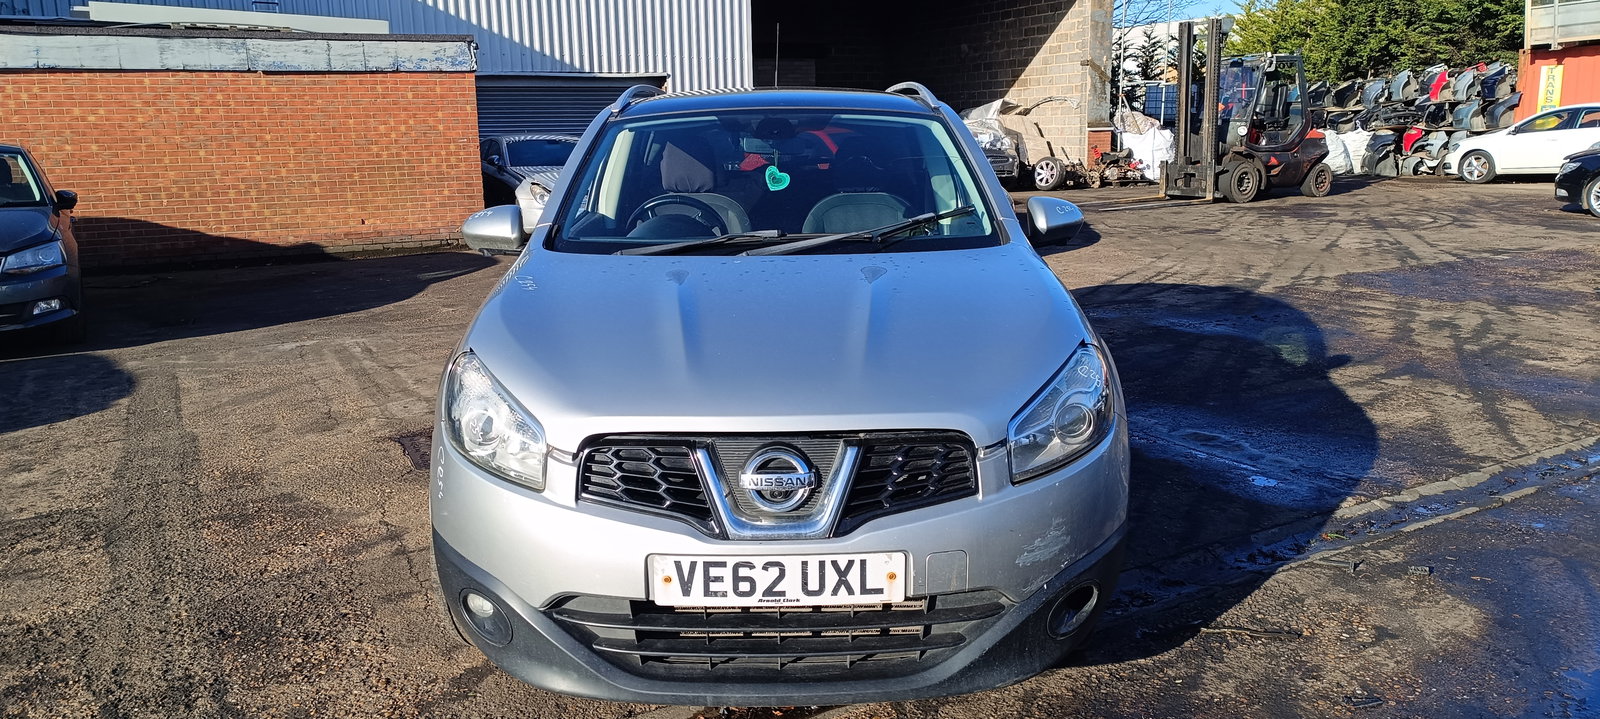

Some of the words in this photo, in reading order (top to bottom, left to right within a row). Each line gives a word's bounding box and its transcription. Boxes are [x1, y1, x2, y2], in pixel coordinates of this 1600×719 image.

[1545, 67, 1556, 103] TRANS
[748, 476, 806, 487] NISSAN
[674, 560, 786, 597] VE62
[801, 559, 884, 596] UXL
